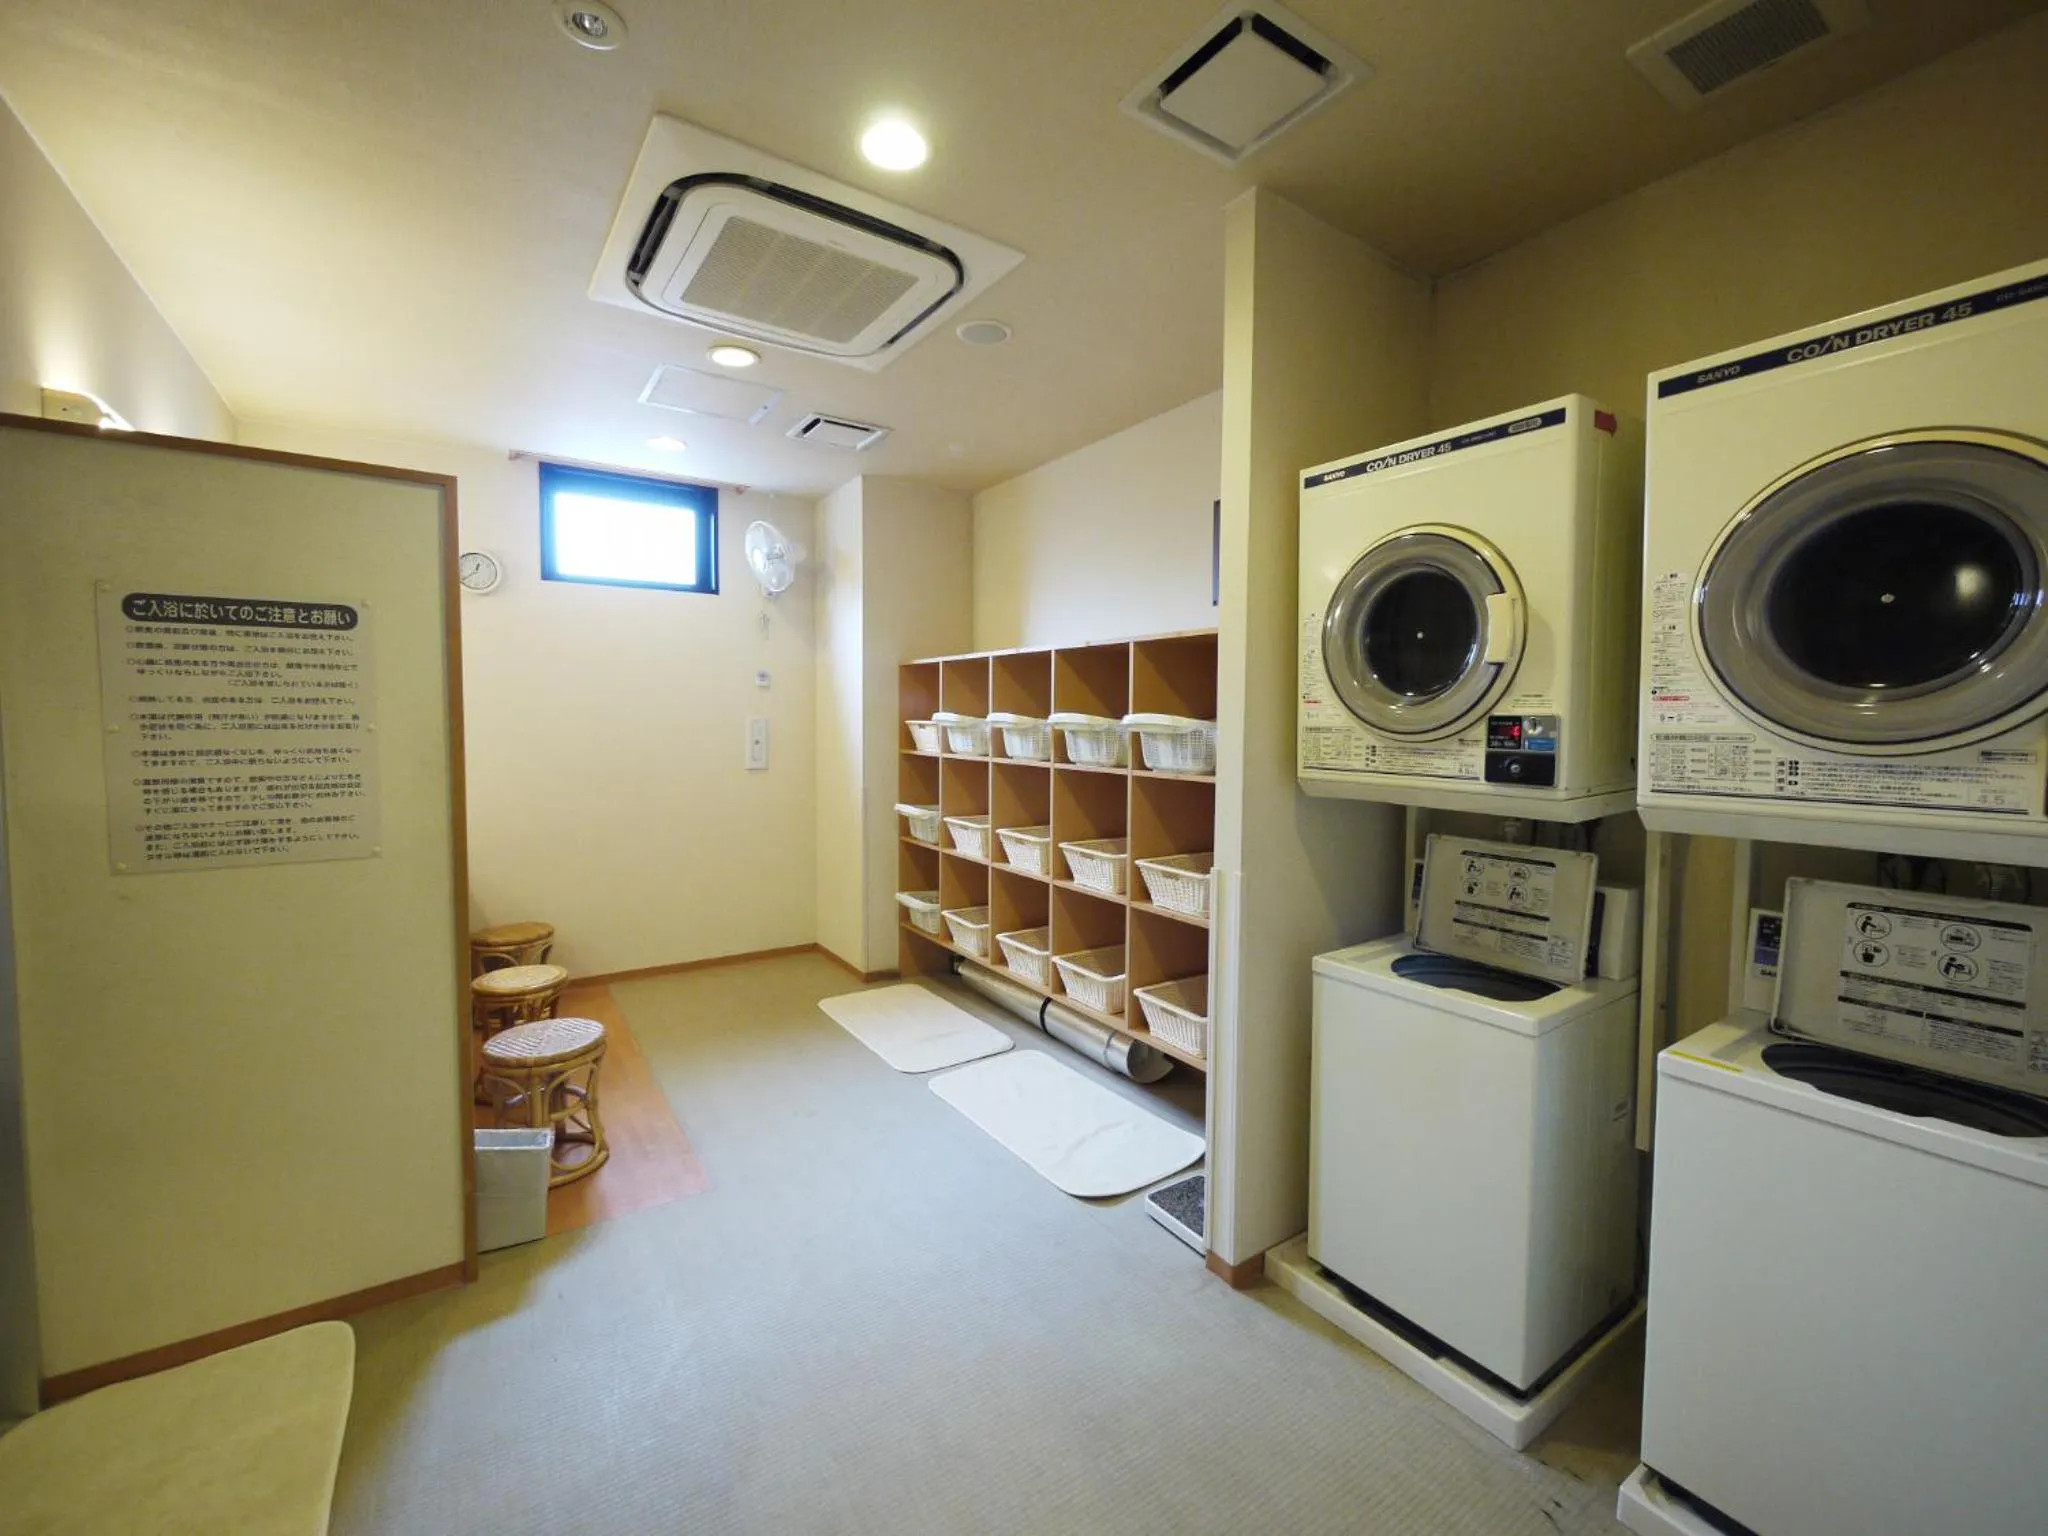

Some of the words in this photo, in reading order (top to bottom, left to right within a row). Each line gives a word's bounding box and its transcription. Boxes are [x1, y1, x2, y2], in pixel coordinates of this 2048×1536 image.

[1696, 365, 1742, 384] SANYO
[1855, 312, 1936, 345] DRYER
[1941, 301, 1973, 323] 45
[1323, 469, 1347, 482] SANYO
[1398, 446, 1436, 465] DRYER
[1436, 442, 1452, 455] 45
[131, 598, 352, 626] ご入浴に於いてのご注意とお願い
